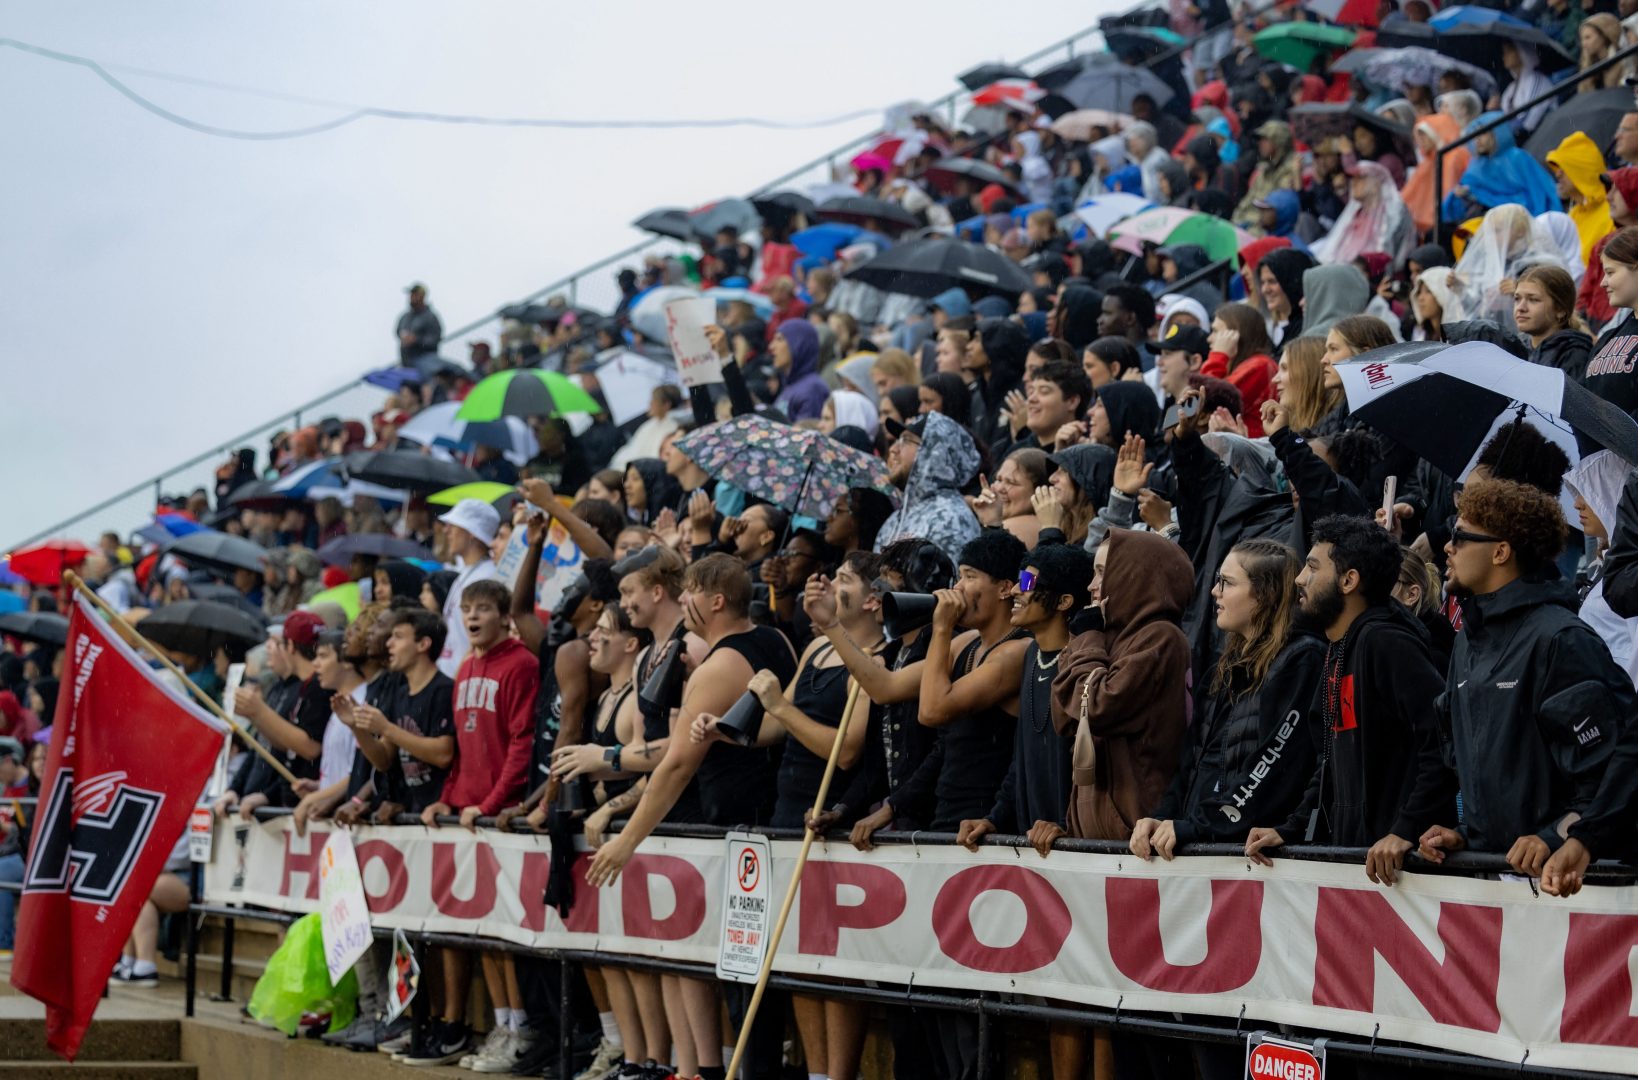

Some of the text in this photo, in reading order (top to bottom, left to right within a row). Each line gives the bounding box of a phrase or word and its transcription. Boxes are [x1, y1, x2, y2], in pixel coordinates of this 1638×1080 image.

[1232, 709, 1300, 808] carhartt
[280, 829, 706, 941] HOUND
[729, 895, 765, 913] NO PARKING
[728, 920, 745, 929] VEHICLES
[746, 922, 756, 930] WILL
[727, 929, 760, 945] TOWED AWAY
[1254, 1053, 1316, 1080] DANGER
